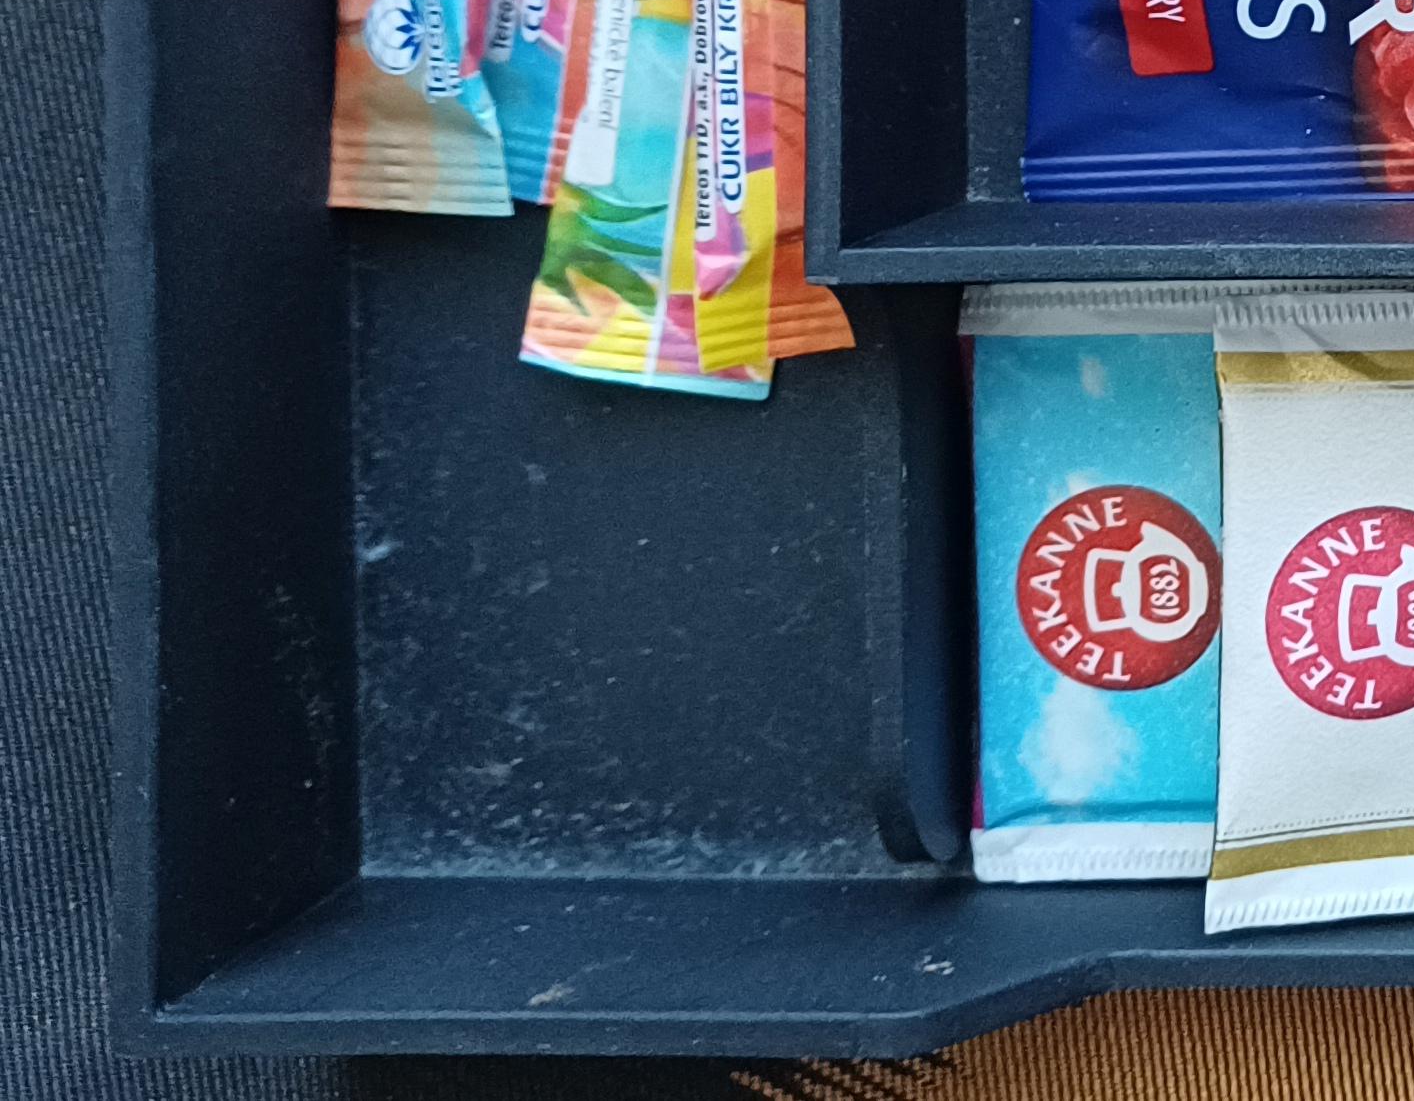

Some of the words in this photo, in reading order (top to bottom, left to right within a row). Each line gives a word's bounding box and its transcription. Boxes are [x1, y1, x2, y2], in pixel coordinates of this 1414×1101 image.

[712, 43, 739, 106] BÍLÝ
[717, 118, 742, 201] CUKR
[1029, 496, 1132, 682] TEEKANNE
[1149, 557, 1181, 617] 1882
[1280, 517, 1386, 710] TEEKANNE
